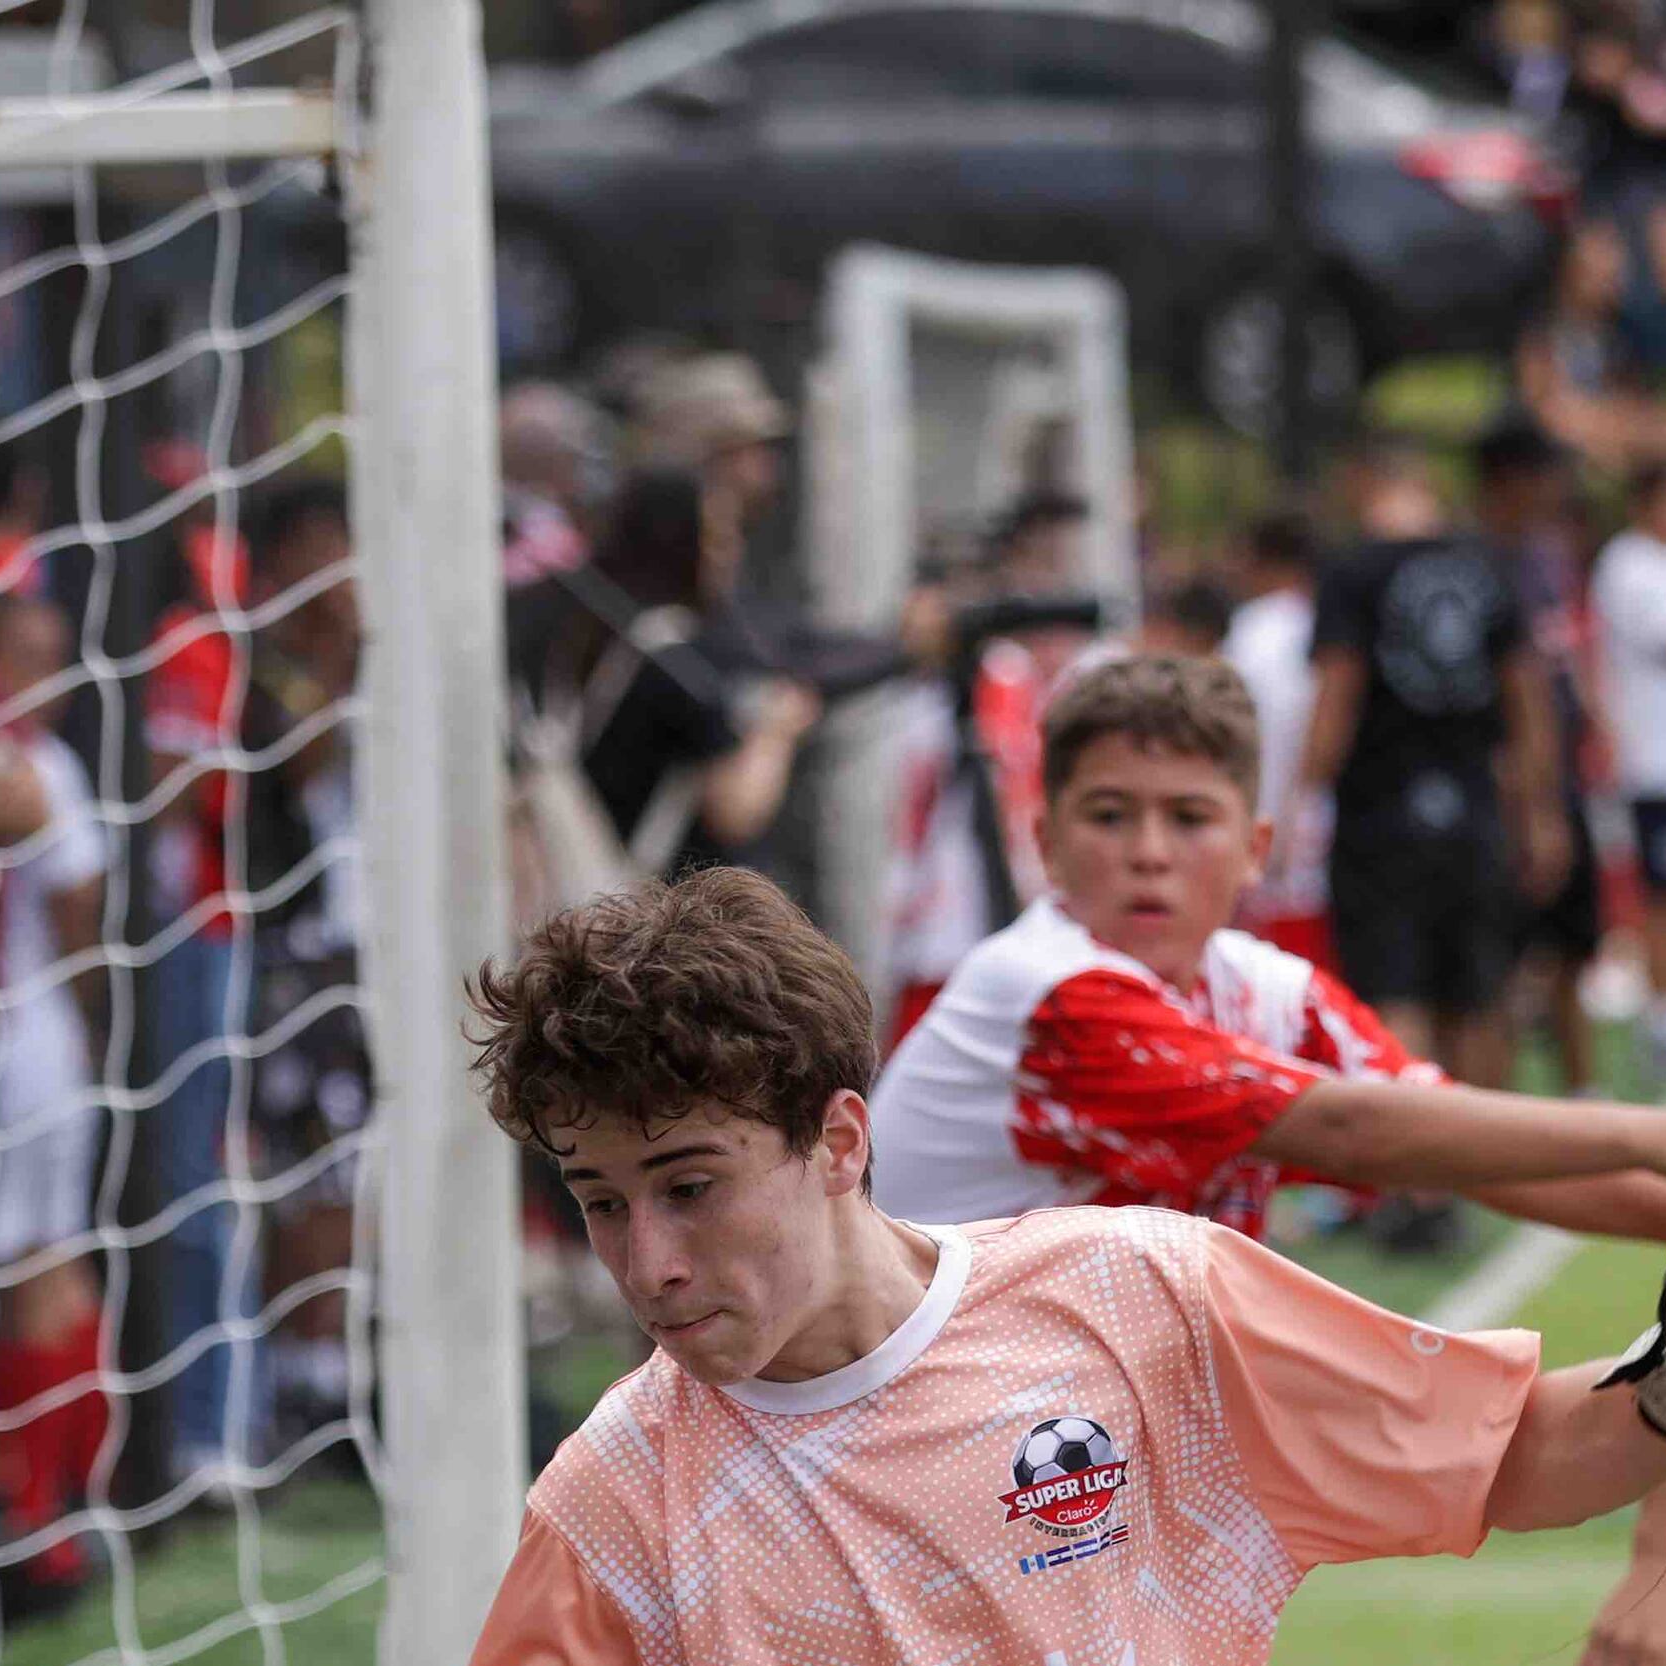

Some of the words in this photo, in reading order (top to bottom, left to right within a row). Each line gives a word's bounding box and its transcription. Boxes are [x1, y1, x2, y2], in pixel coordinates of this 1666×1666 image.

[1015, 1478, 1081, 1514] SUPER
[1083, 1467, 1122, 1494] LIGA
[1056, 1506, 1093, 1523] Claro
